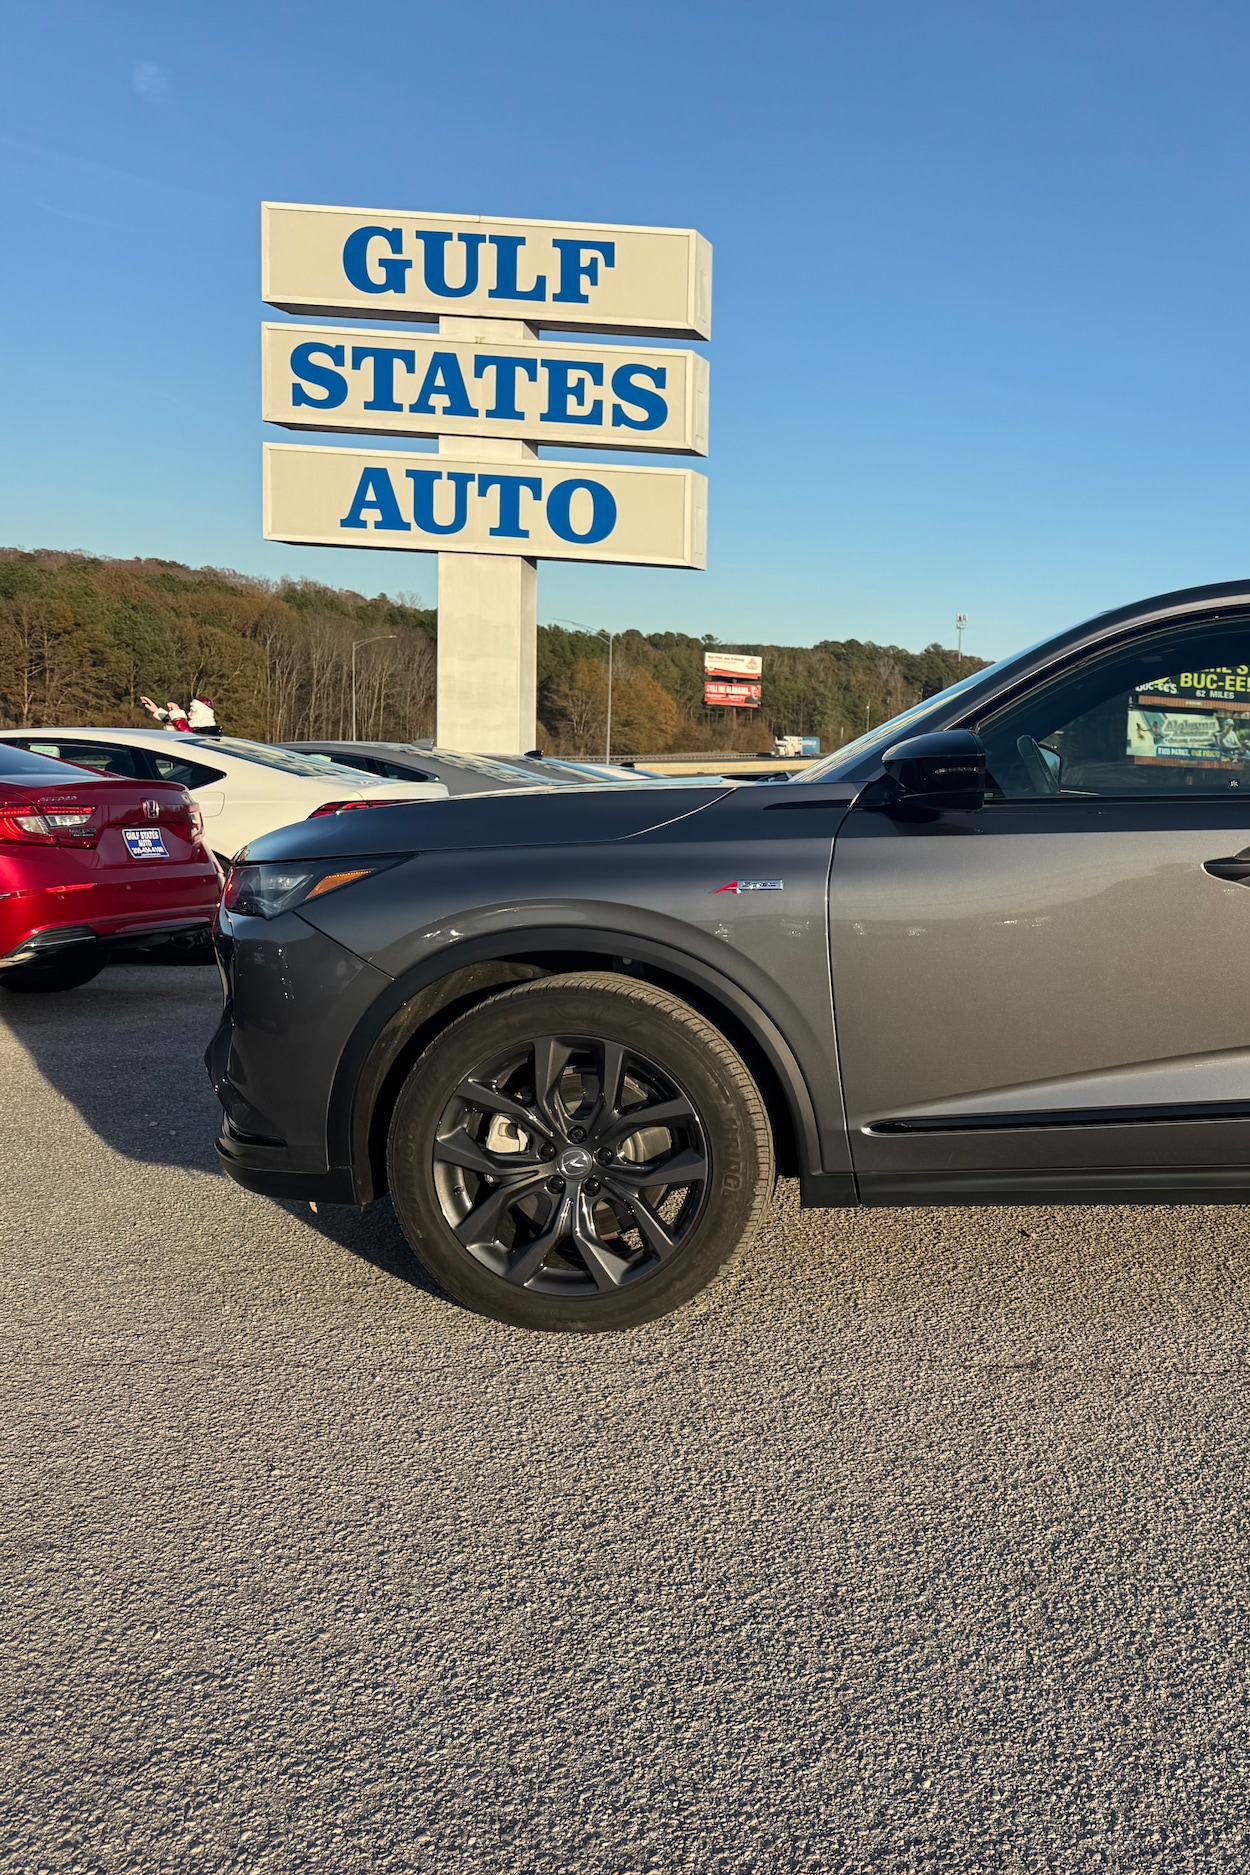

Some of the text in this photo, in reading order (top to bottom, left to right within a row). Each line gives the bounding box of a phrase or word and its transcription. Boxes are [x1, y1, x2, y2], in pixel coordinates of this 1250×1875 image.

[342, 225, 616, 304] GULF
[289, 341, 669, 431] STATES
[339, 466, 618, 545] AUTO
[1195, 690, 1235, 699] 62 MILES
[126, 831, 159, 840] GULF STATES
